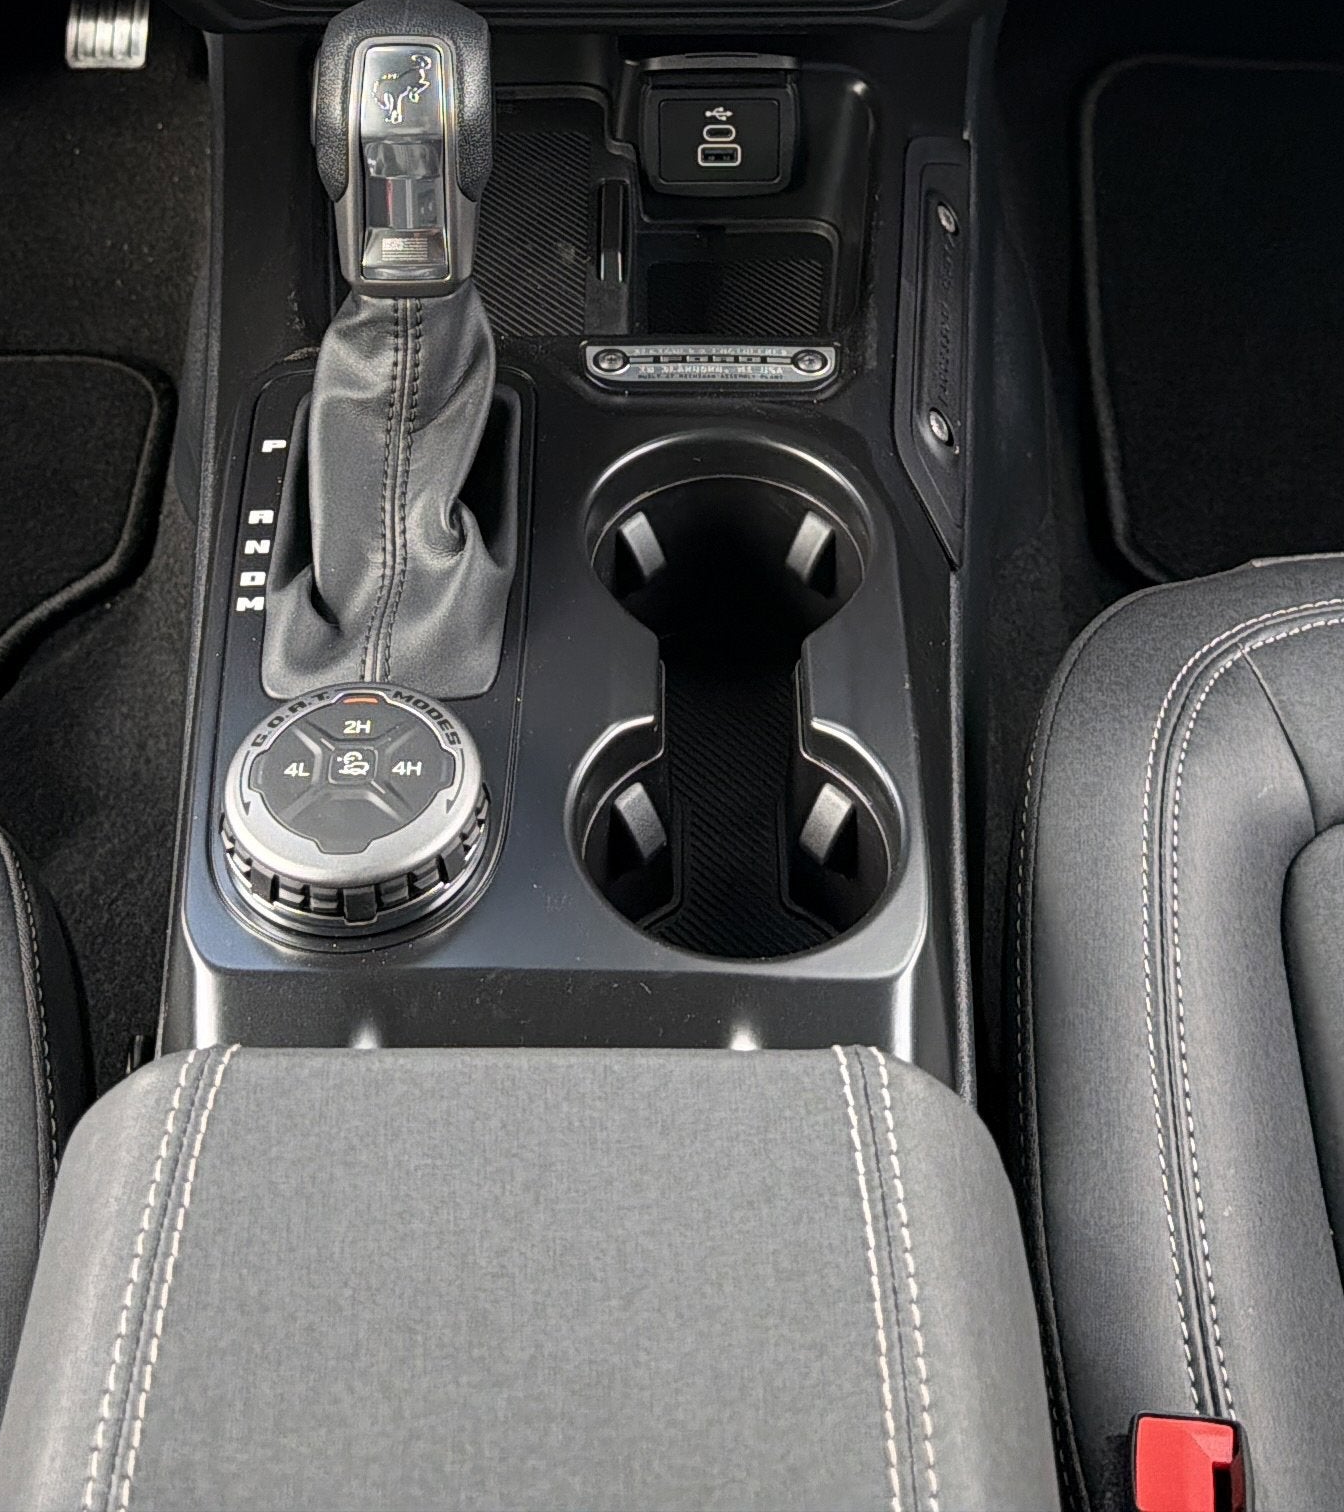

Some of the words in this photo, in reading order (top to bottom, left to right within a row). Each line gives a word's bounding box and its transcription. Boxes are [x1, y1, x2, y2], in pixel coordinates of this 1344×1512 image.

[261, 439, 287, 453] P
[244, 539, 270, 554] N
[236, 596, 265, 611] M
[392, 690, 462, 746] MODES
[343, 719, 372, 734] 2H
[284, 762, 310, 777] 4L
[392, 761, 422, 777] 4H
